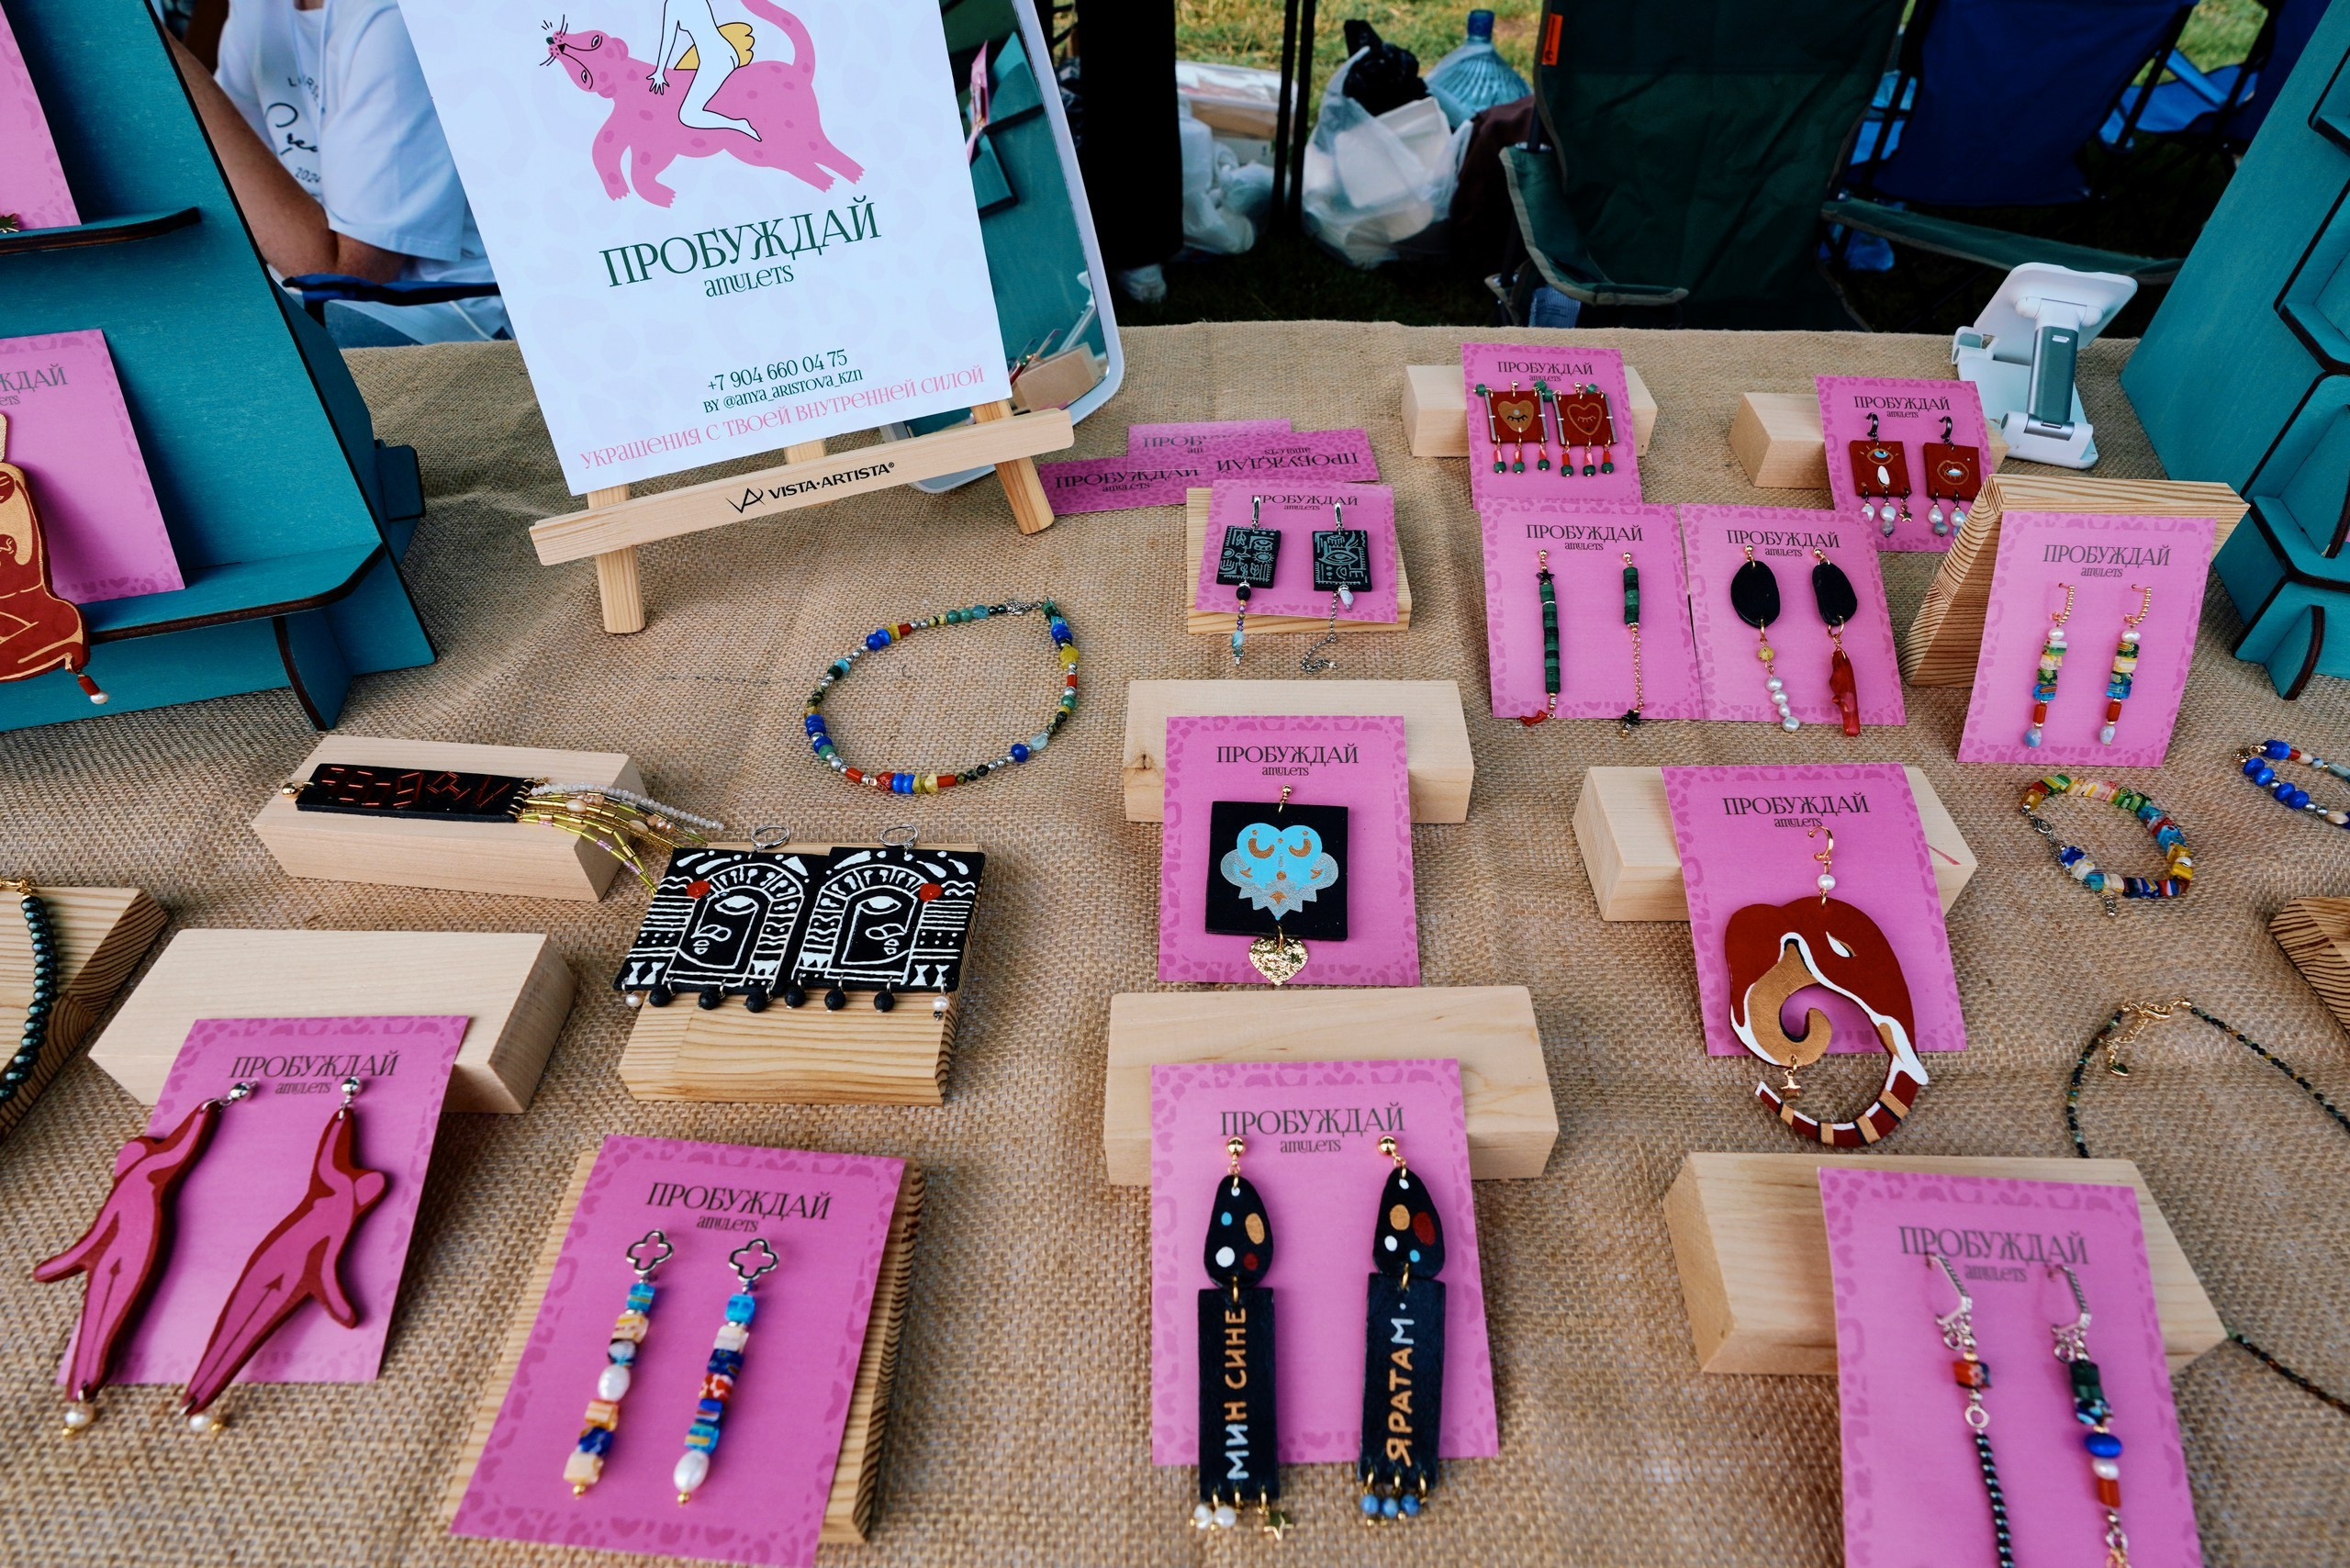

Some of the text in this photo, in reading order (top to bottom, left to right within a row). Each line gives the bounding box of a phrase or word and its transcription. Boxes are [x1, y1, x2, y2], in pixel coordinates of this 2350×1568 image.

[599, 195, 881, 287] ПРОБУЖДАЙ
[708, 349, 847, 391] +7 904 660 04 75
[921, 364, 985, 394] СИЛОЙ
[1497, 361, 1594, 376] ПРОБУЖДАЙ
[1853, 396, 1951, 412] ПРОБУЖДАЙ
[1526, 523, 1644, 543] ПРОБУЖДАЙ
[1726, 529, 1841, 549] ПРОБУЖДАЙ
[2042, 544, 2172, 568] ПРОБУЖДАЙ
[1216, 743, 1360, 767] ПРОБУЖДАЙ
[1722, 792, 1871, 817] ПРОБУЖДАЙ
[229, 1049, 401, 1081] ПРОБУЖДАЙ
[1219, 1102, 1406, 1137] ПРОБУЖДАЙ
[645, 1182, 834, 1222] ПРОБУЖДАЙ
[1898, 1226, 2090, 1266] ПРОБУЖДАЙ
[1224, 1306, 1249, 1481] МИН СИНЕ
